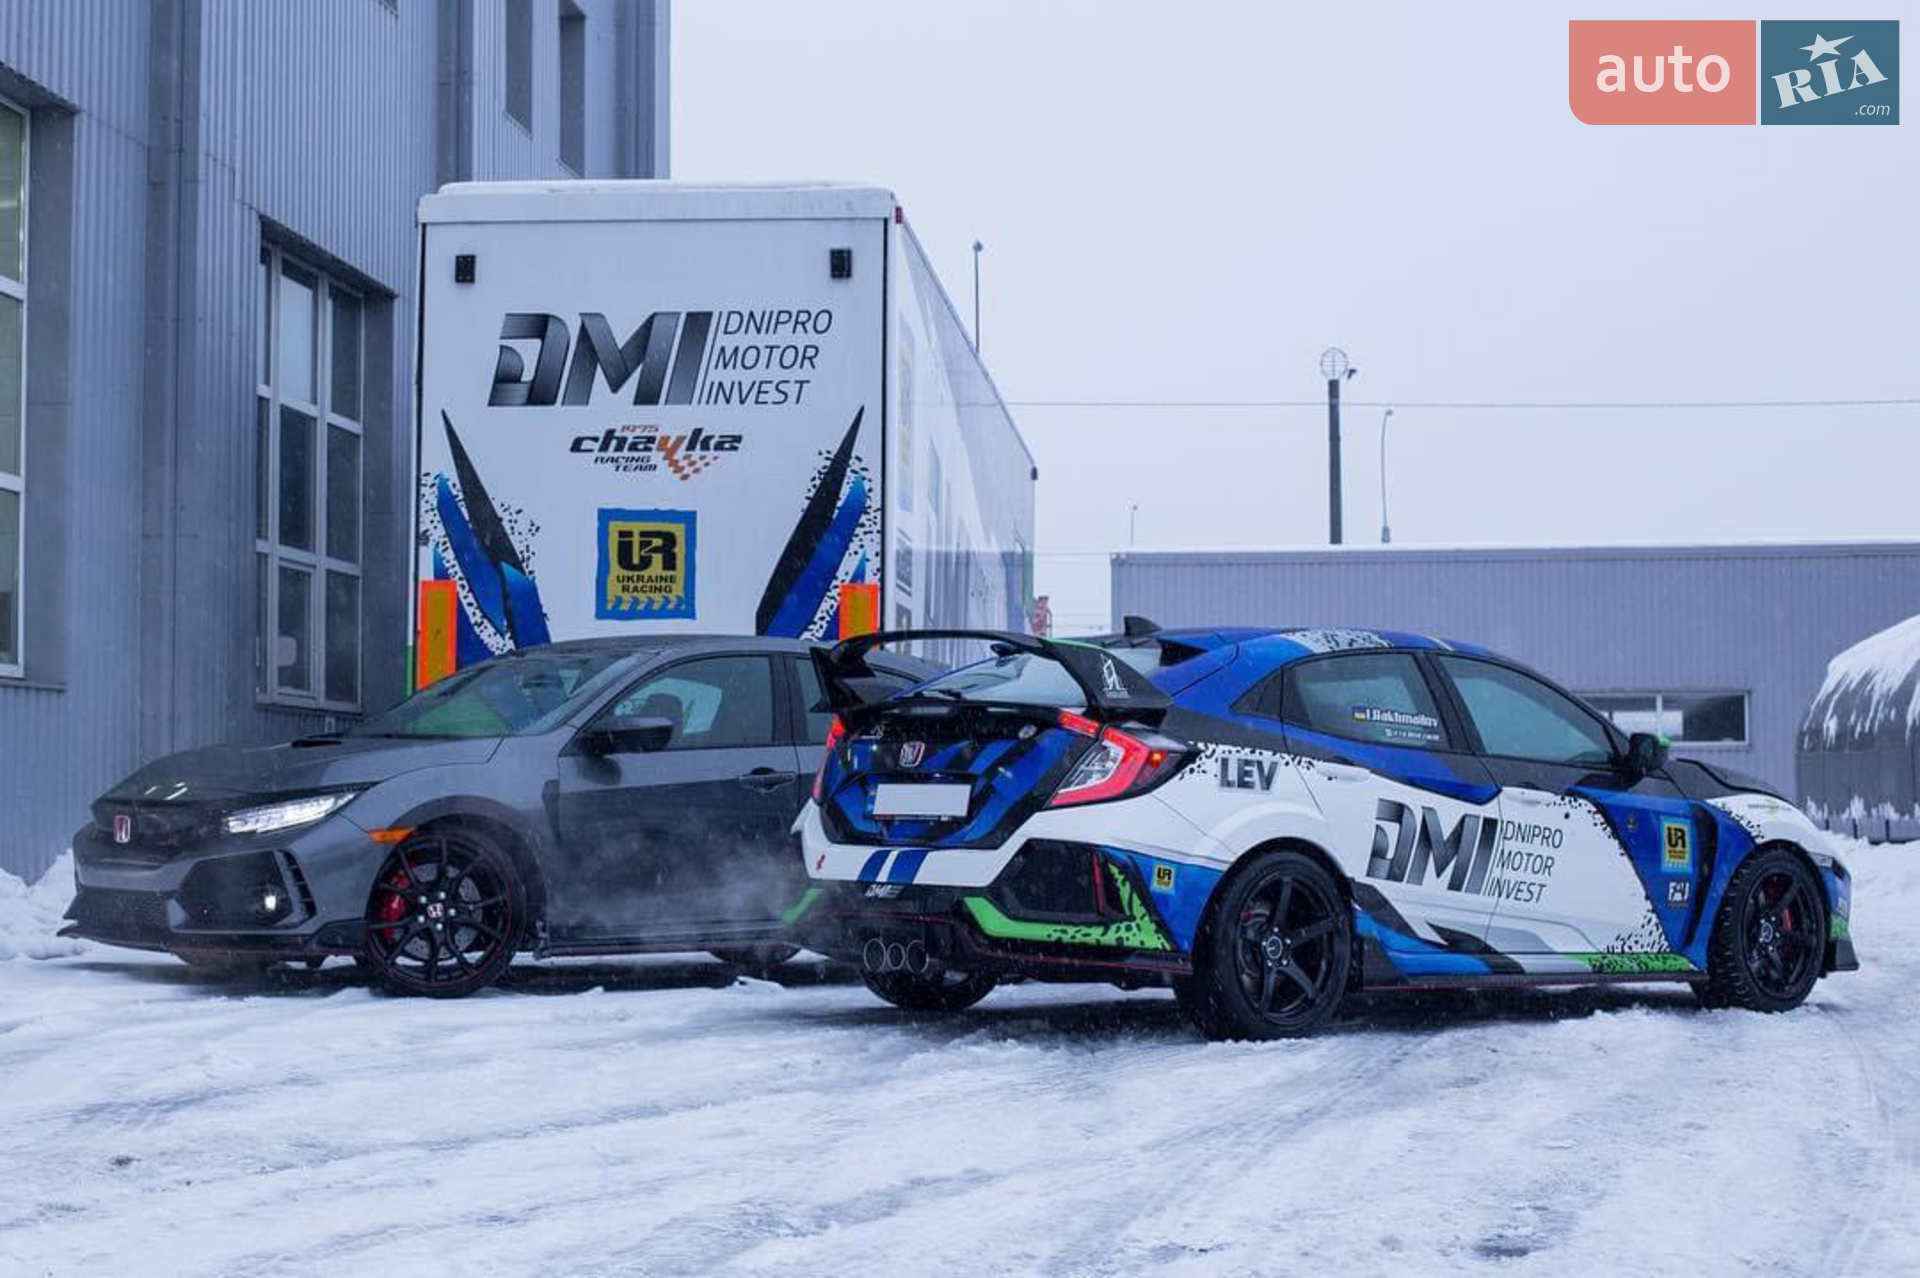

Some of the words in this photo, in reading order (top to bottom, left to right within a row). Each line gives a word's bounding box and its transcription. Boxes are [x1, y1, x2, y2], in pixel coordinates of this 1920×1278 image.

[723, 309, 833, 335] DNIPRO
[488, 312, 713, 406] DMI
[714, 345, 820, 370] MOTOR
[705, 380, 811, 405] INVEST
[614, 464, 657, 472] TEAM
[616, 574, 677, 584] UKRAINE
[621, 584, 673, 594] RACING
[1220, 757, 1279, 791] LEV
[1366, 798, 1500, 895] DMI
[1503, 820, 1564, 849] DNIPRO
[1496, 850, 1554, 876] MOTOR
[1488, 877, 1547, 904] INVEST
